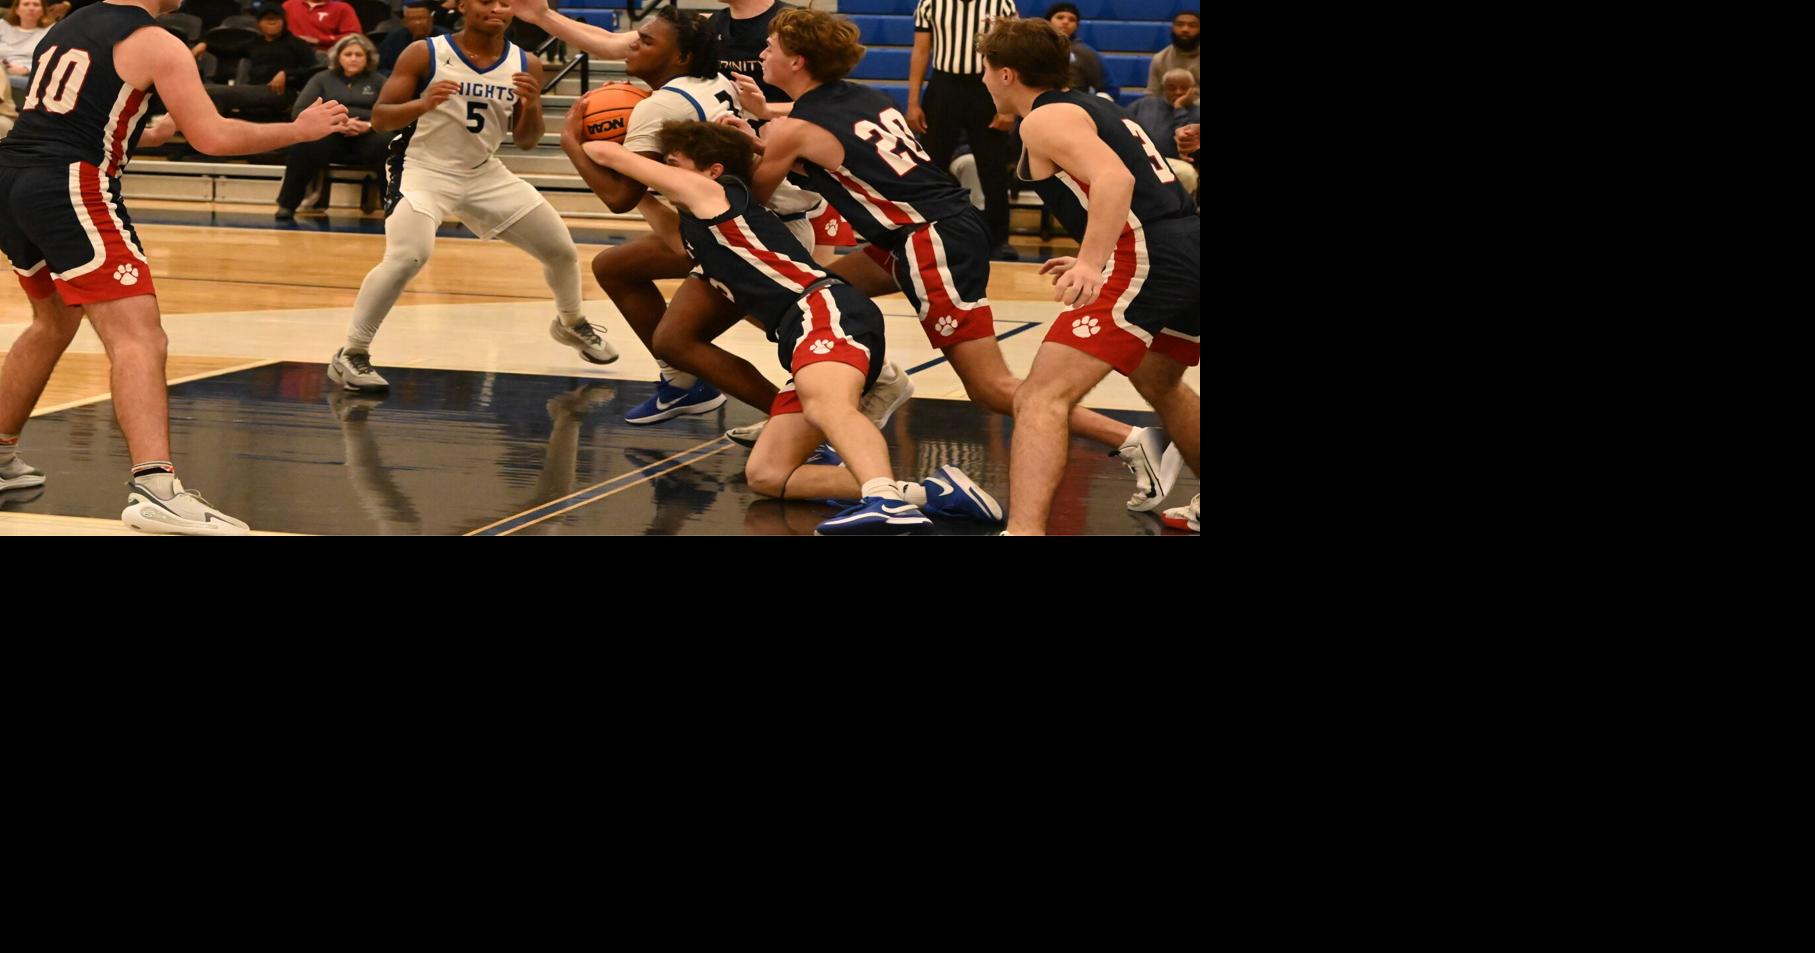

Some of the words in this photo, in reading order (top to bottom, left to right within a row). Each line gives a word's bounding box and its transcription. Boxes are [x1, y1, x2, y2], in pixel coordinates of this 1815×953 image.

[22, 44, 92, 115] 10
[455, 82, 515, 101] NIGHTS
[465, 100, 489, 134] 5
[587, 117, 625, 135] NCAA
[1120, 118, 1176, 184] 3
